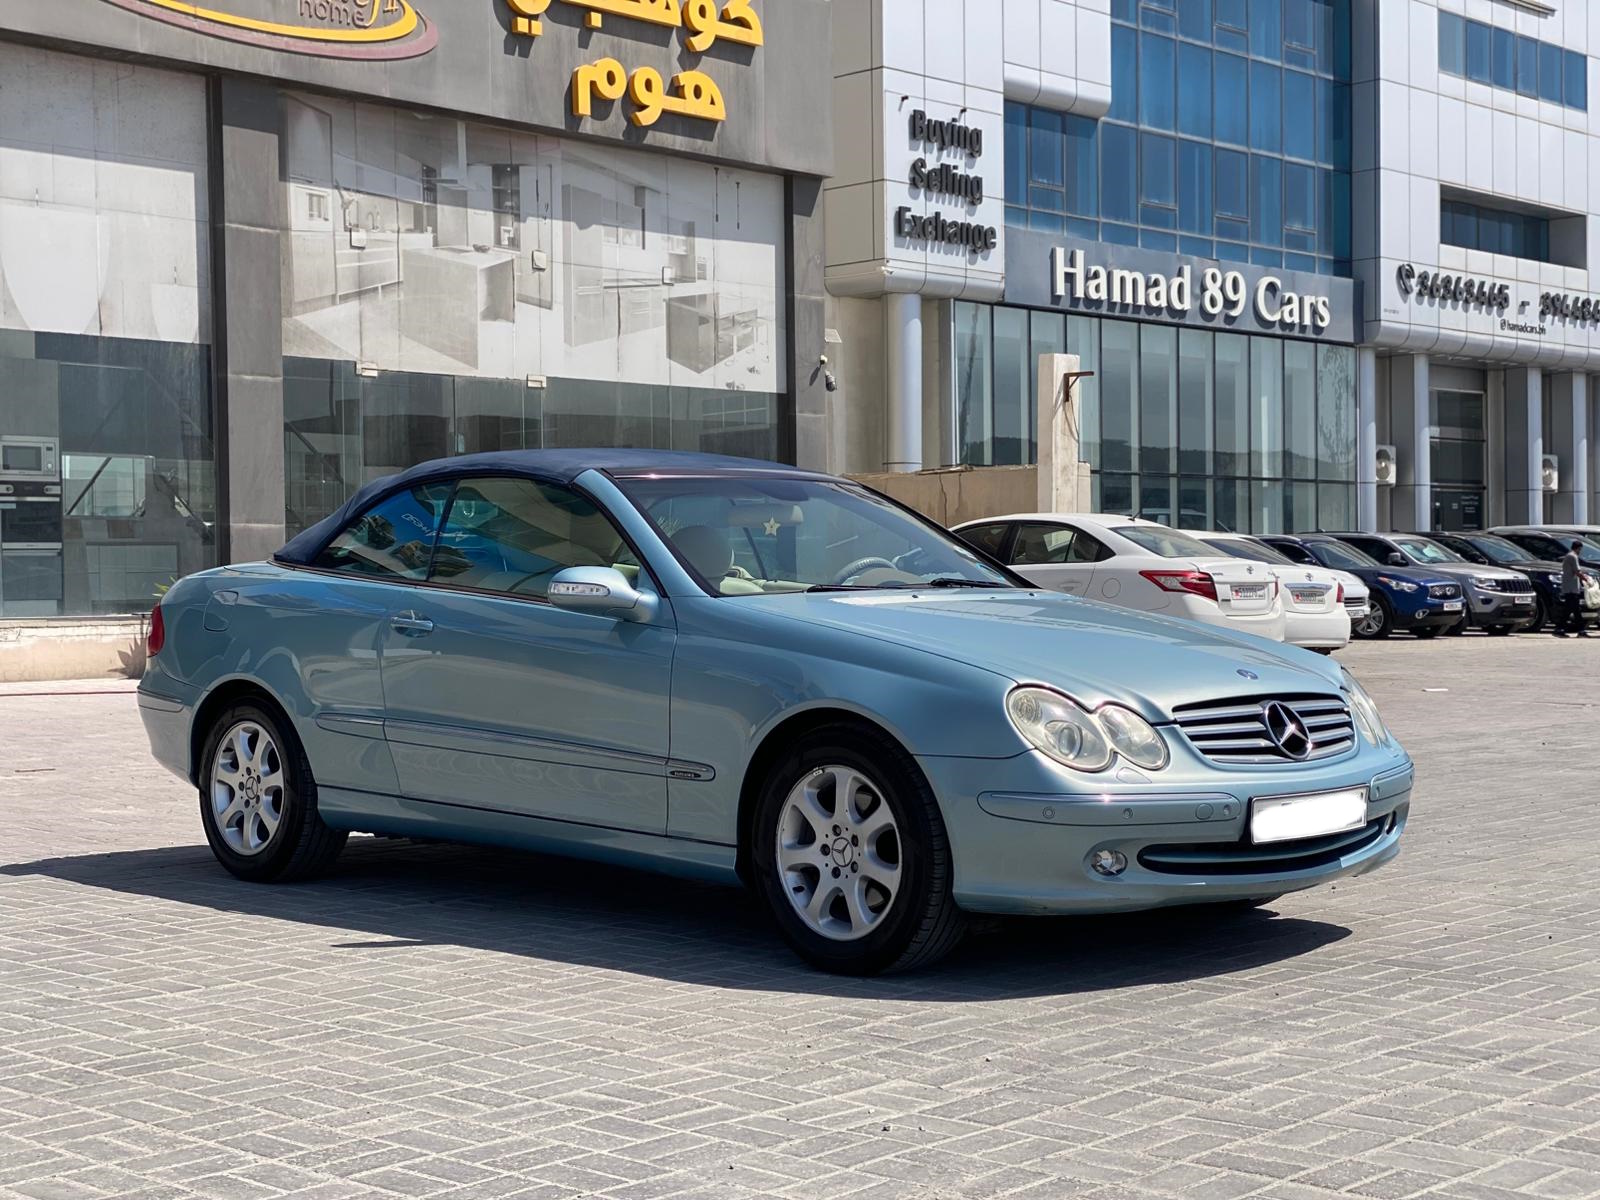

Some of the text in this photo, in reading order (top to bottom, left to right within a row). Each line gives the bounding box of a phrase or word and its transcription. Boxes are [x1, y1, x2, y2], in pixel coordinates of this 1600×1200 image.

[572, 57, 726, 126] هوم
[910, 109, 982, 157] Buying
[911, 158, 983, 206] Selling
[896, 206, 997, 253] Exchange
[1052, 247, 1331, 327] Hamad 89 Cars
